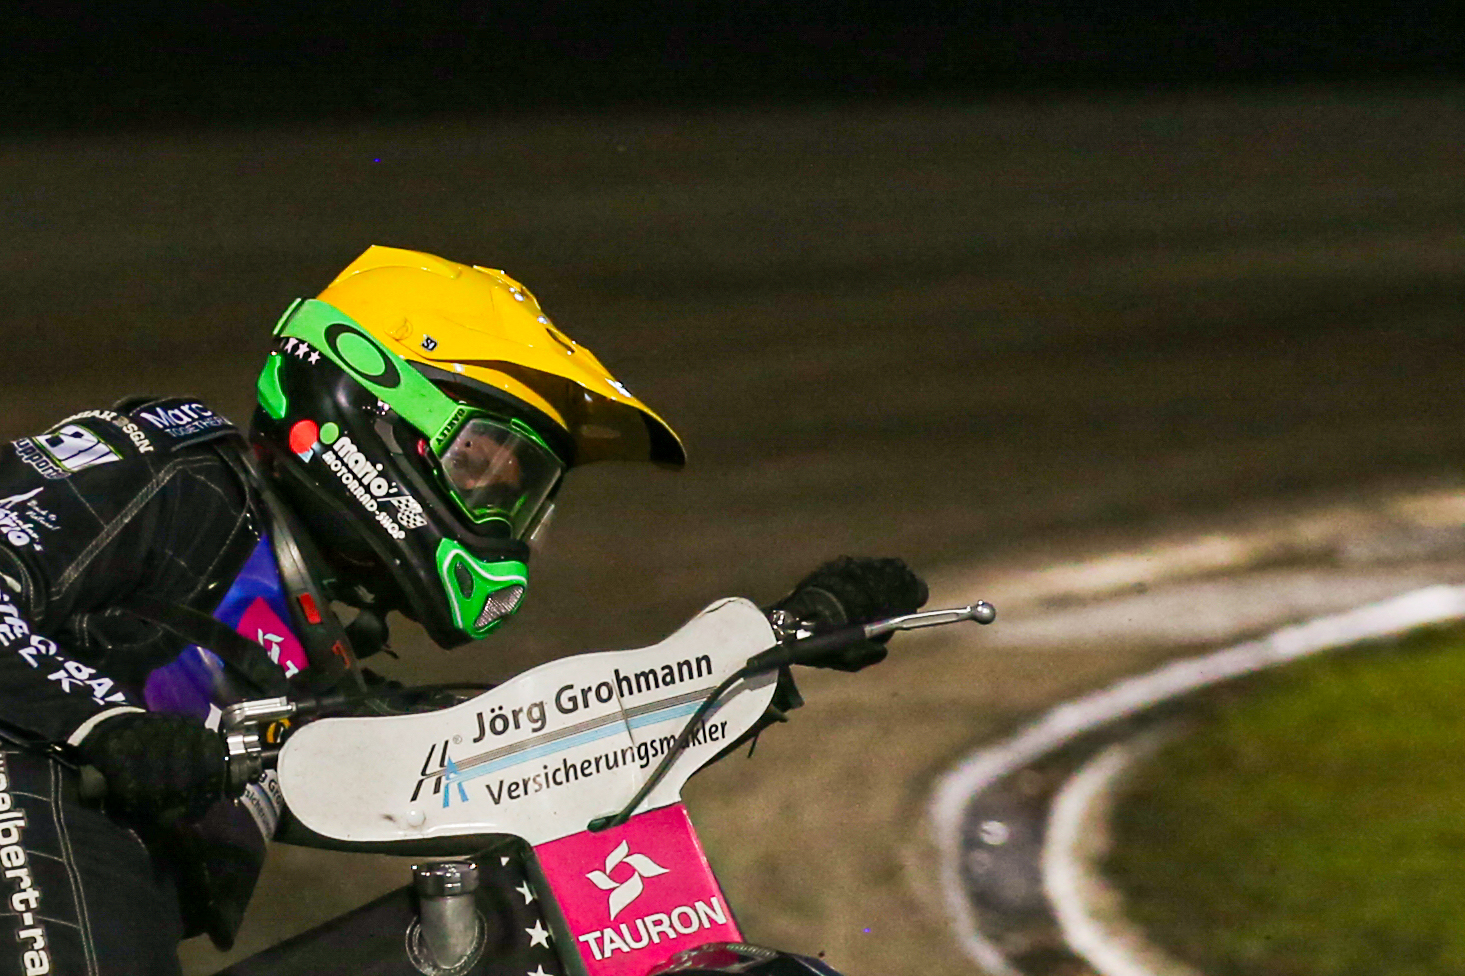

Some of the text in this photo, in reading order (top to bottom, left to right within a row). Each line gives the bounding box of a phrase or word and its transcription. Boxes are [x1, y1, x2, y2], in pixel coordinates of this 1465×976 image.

[472, 654, 713, 744] Jörg Grohmann
[484, 719, 729, 805] Versicherungsmkler
[578, 896, 727, 961] TAURON
